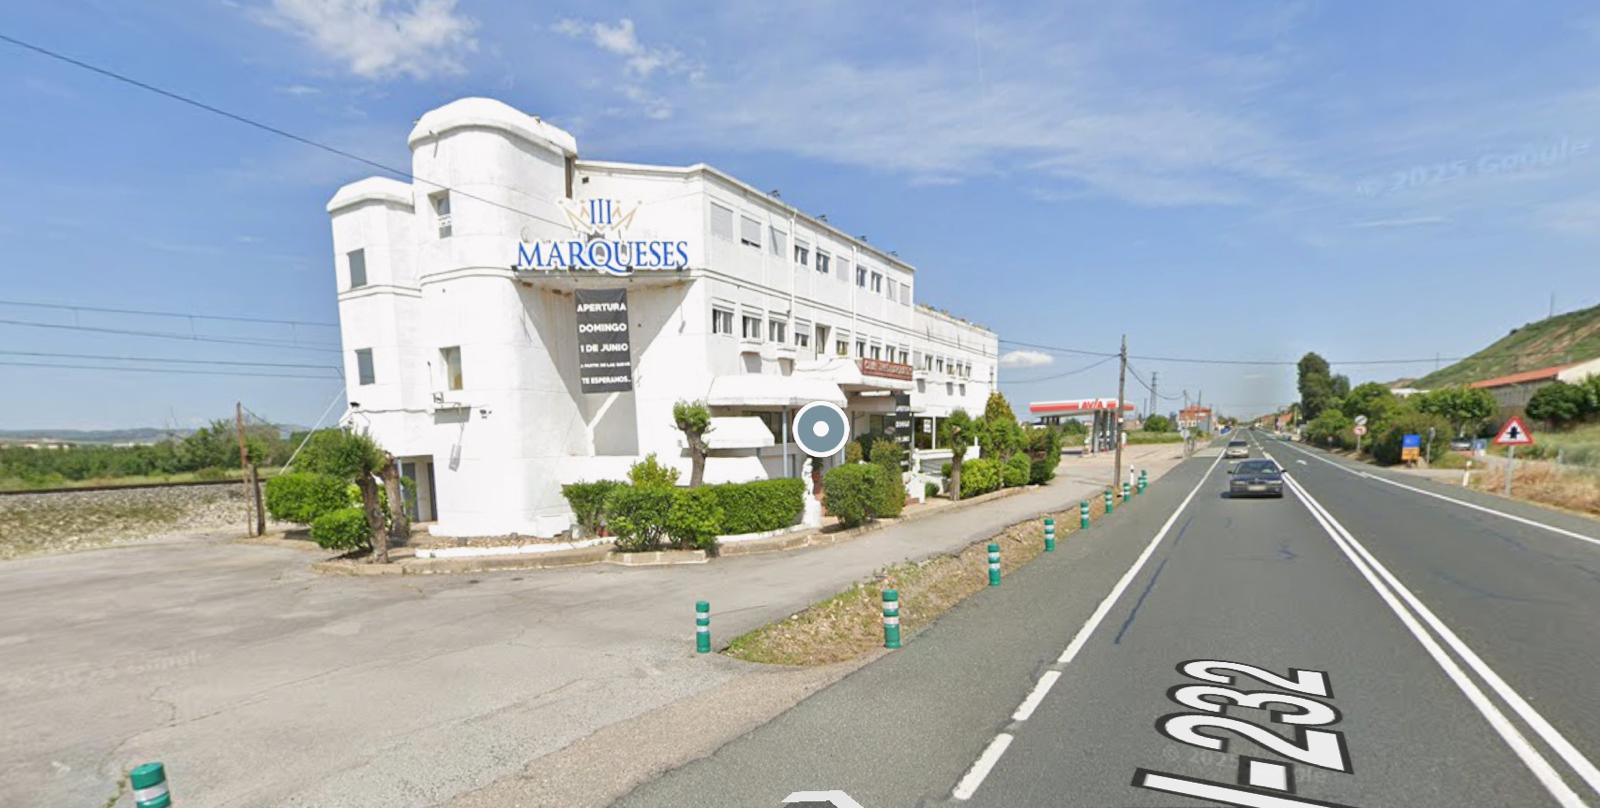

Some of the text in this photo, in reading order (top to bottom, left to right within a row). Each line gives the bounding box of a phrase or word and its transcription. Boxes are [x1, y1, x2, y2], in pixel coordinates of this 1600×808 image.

[589, 198, 612, 225] III
[517, 240, 688, 273] MARQUESES
[577, 302, 627, 312] APERTURA
[579, 323, 627, 333] DOMINGO
[580, 343, 628, 353] 1 DE JUNIO
[1082, 399, 1103, 409] AVIA
